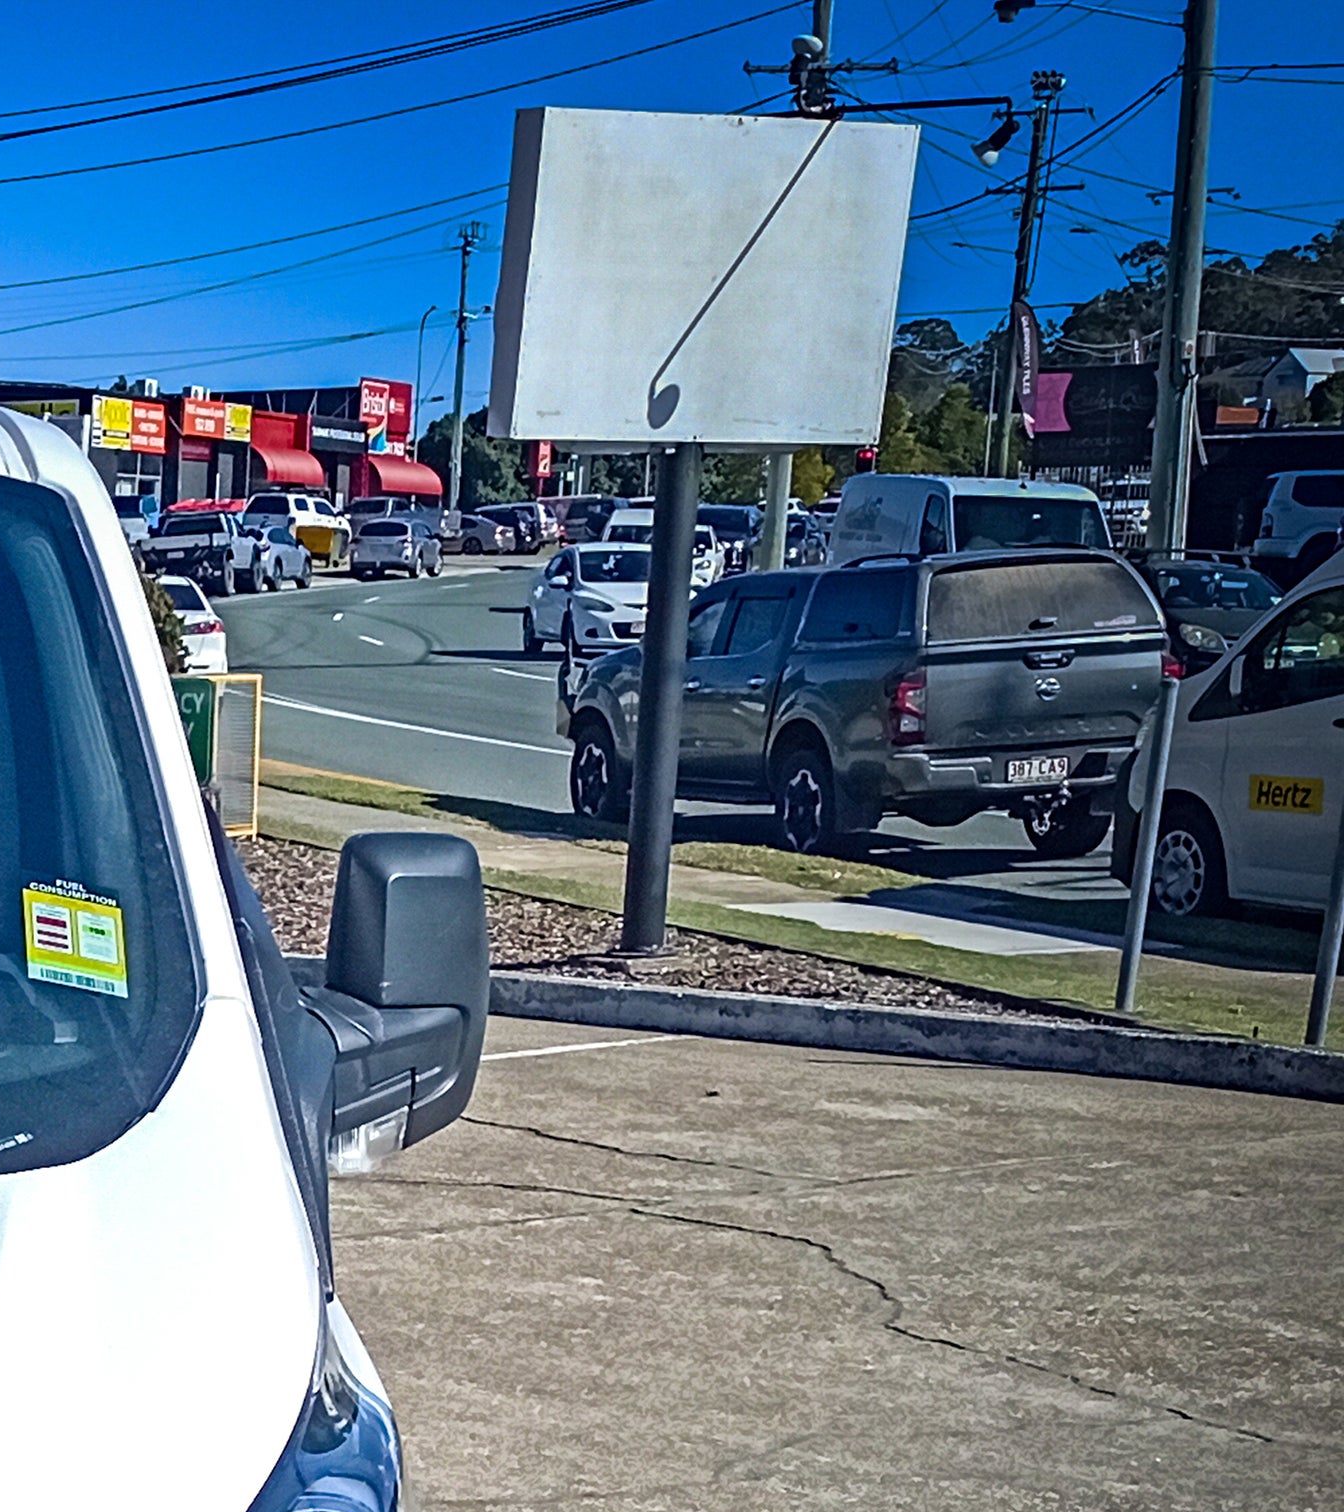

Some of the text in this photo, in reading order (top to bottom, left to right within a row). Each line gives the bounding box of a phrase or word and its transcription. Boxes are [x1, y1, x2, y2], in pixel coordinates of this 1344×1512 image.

[1038, 759, 1066, 775] CA9
[1256, 781, 1312, 808] Hertz
[29, 882, 117, 906] CONSUMPTION
[56, 879, 87, 892] FUEL
